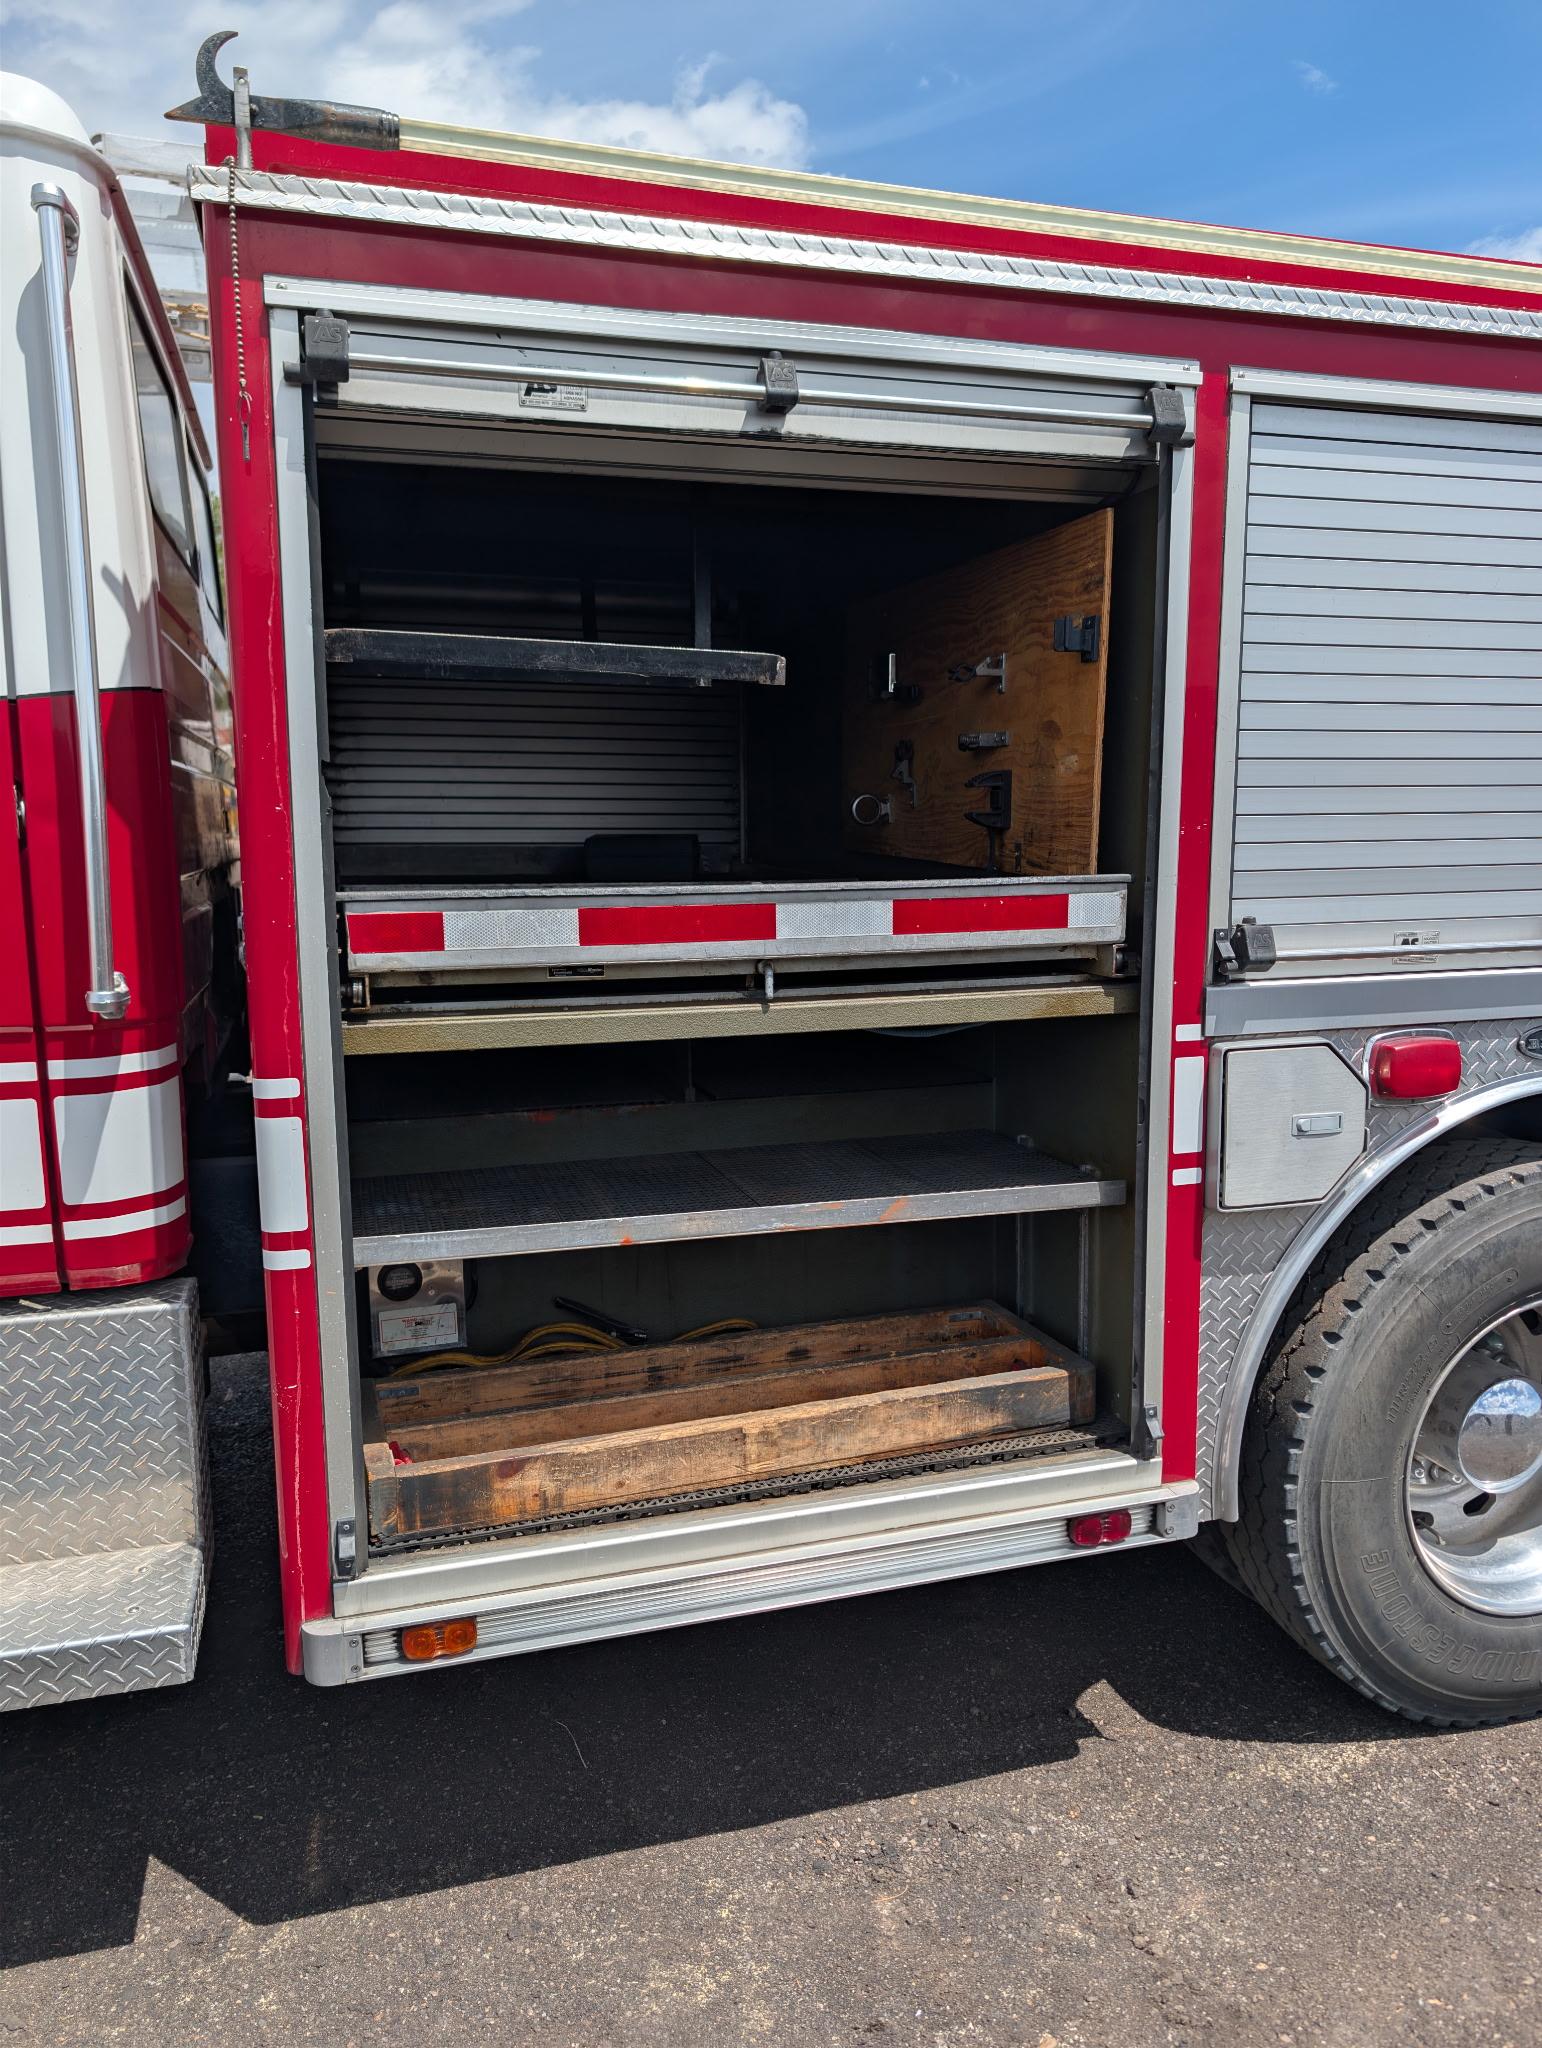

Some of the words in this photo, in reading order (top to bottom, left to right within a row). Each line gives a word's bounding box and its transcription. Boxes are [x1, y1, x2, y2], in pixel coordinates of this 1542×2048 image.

[311, 325, 342, 344] AS
[768, 366, 794, 382] AS
[1360, 1548, 1542, 1683] RIDGESTONE
